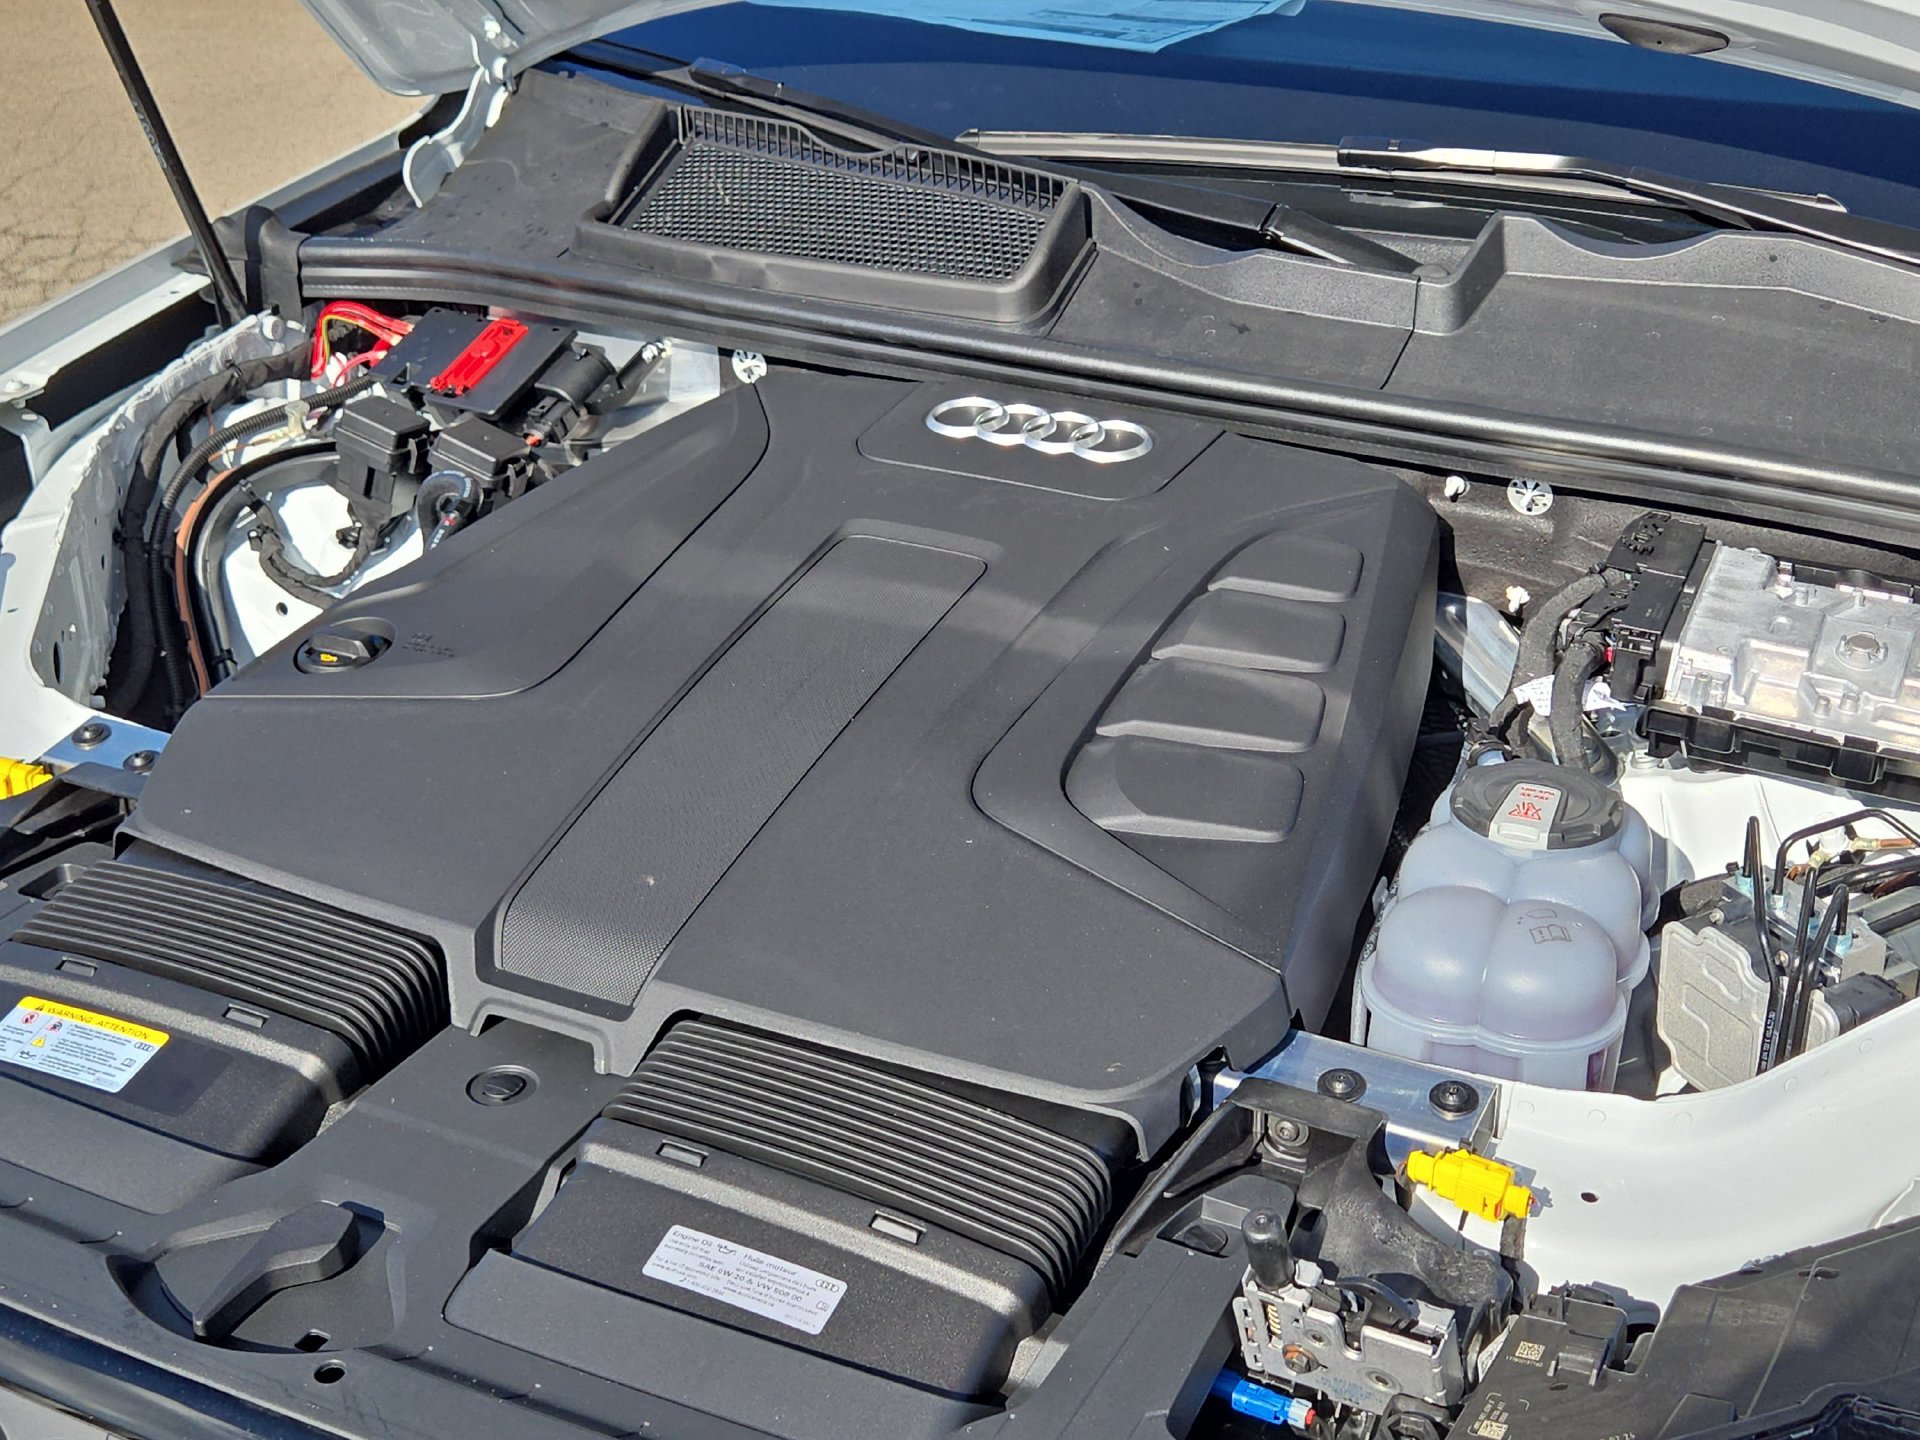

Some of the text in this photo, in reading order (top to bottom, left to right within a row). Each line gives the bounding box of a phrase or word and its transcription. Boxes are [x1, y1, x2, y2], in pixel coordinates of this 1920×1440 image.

[48, 1007, 93, 1023] WARNING
[96, 1020, 149, 1040] ATTENTION
[673, 1230, 699, 1242] Engine
[699, 1262, 715, 1271] SAE
[757, 1281, 773, 1290] VW
[743, 1254, 796, 1275] Huile moteur
